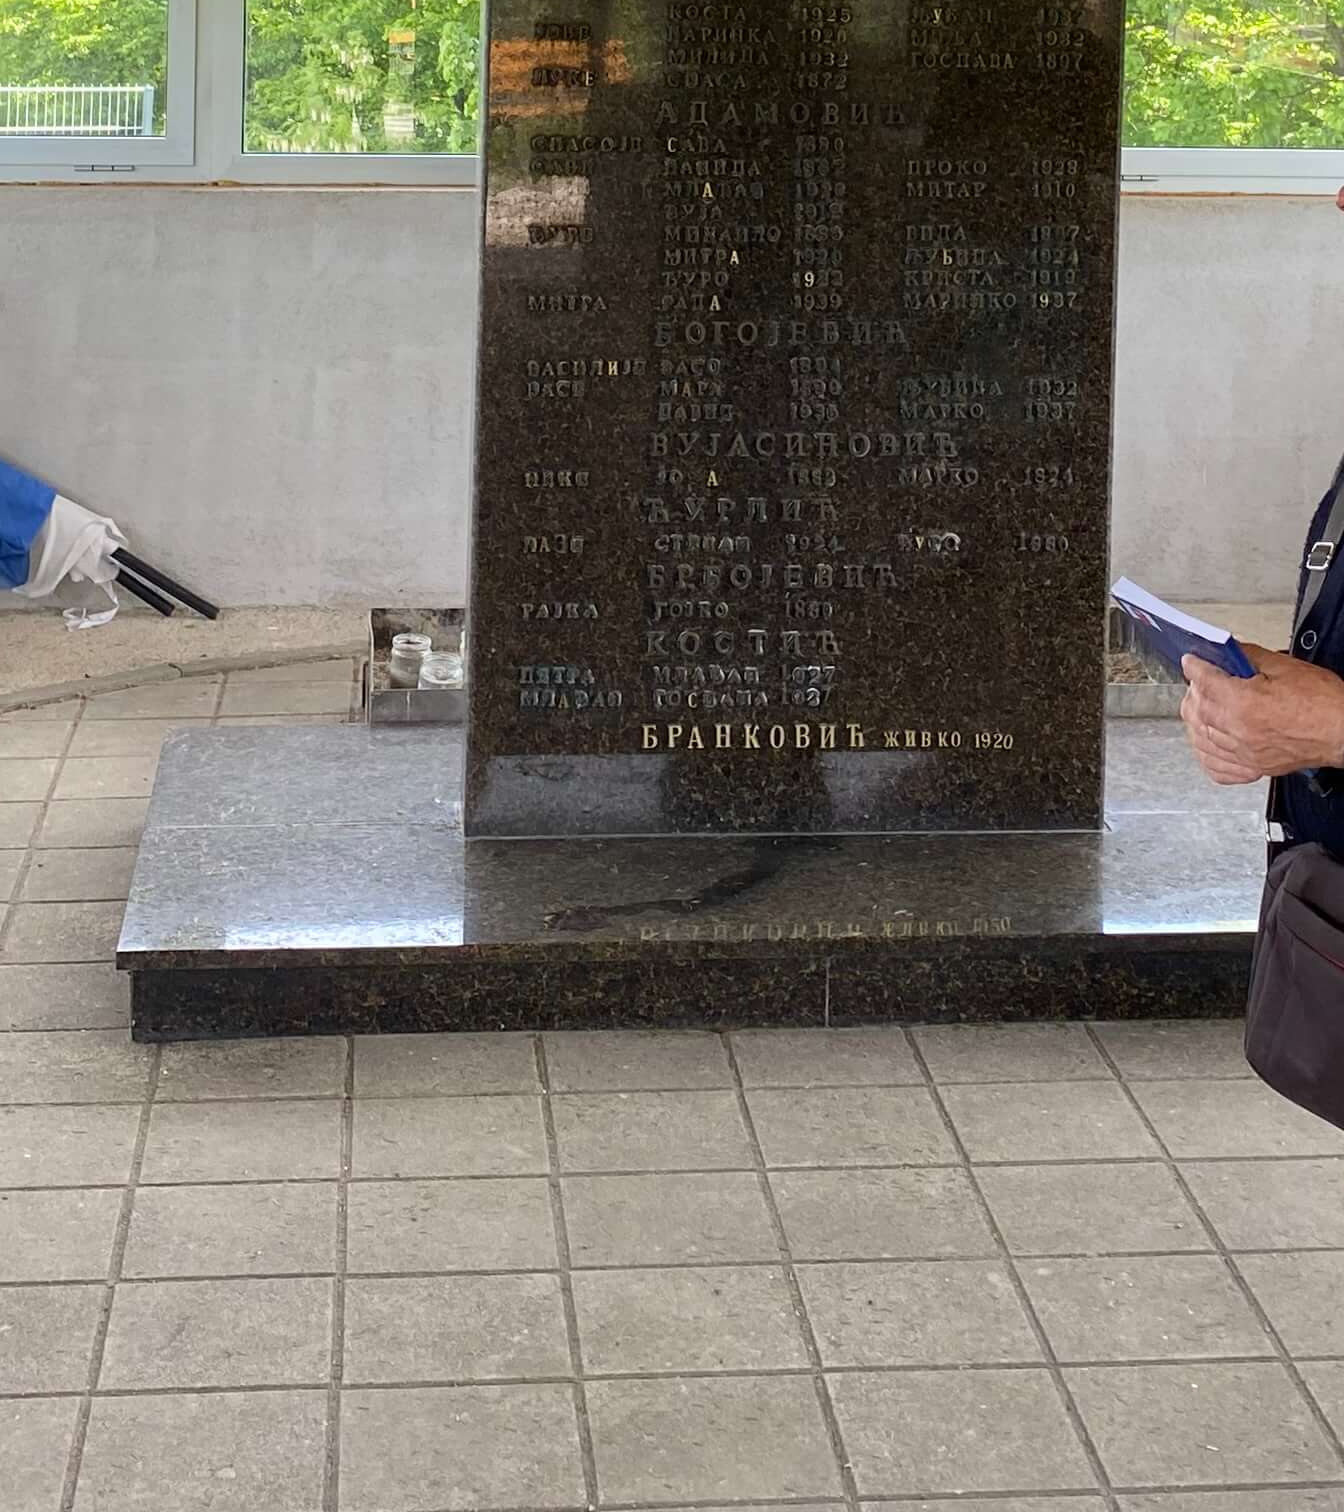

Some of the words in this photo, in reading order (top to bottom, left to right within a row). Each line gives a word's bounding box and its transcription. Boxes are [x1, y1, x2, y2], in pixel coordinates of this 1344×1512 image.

[668, 4, 747, 22] КОСТА
[654, 100, 907, 127] АДАМОВИЋ
[906, 158, 988, 177] ПРОКО
[1030, 158, 1079, 177] 1928
[654, 321, 909, 348] БОГОЈЕВИЋ
[650, 431, 959, 457] ВУЈАСИНОВИЋ
[645, 628, 843, 657] КОСТИЋ
[641, 723, 865, 749] БРАНКОВИЋ
[883, 729, 962, 748] ЖИВКО
[975, 731, 1014, 750] 1920
